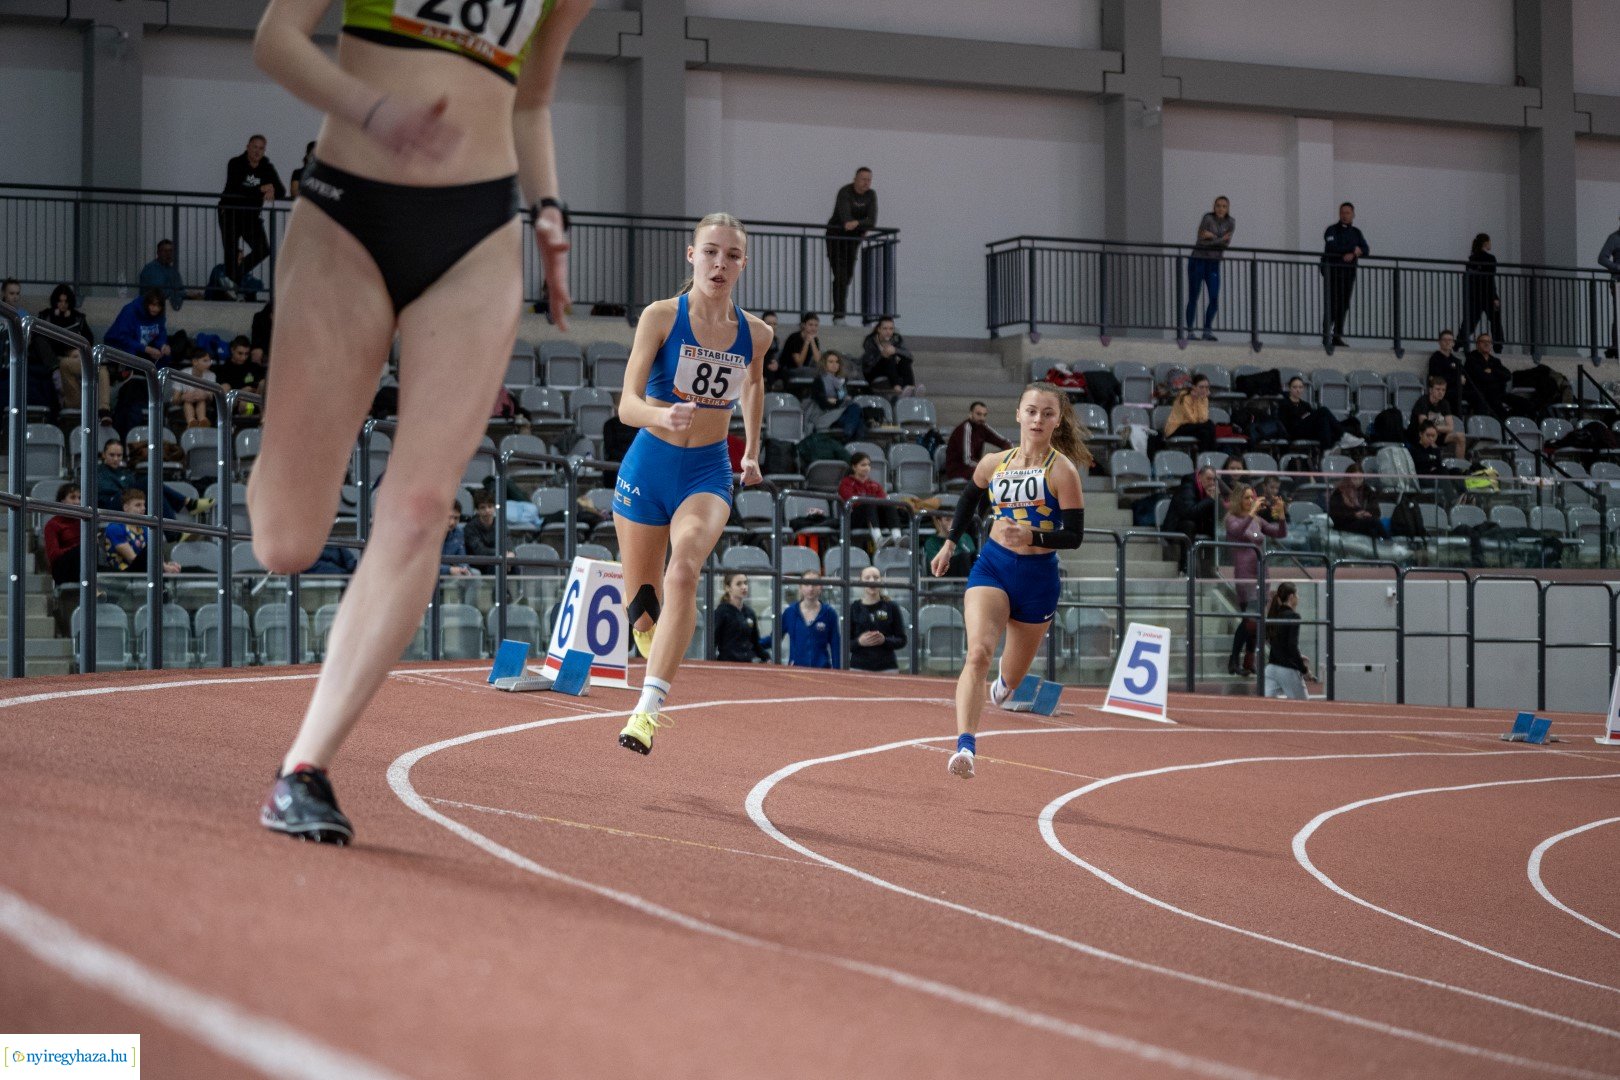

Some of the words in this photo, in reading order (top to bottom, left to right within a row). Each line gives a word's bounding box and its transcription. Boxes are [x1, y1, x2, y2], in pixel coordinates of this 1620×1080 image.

[692, 363, 732, 398] 85
[686, 394, 726, 406] ATLETIKA
[999, 476, 1037, 502] 270
[1005, 468, 1043, 476] STABILITA
[557, 579, 581, 649] 6
[587, 584, 622, 656] 6
[1123, 640, 1162, 695] 5
